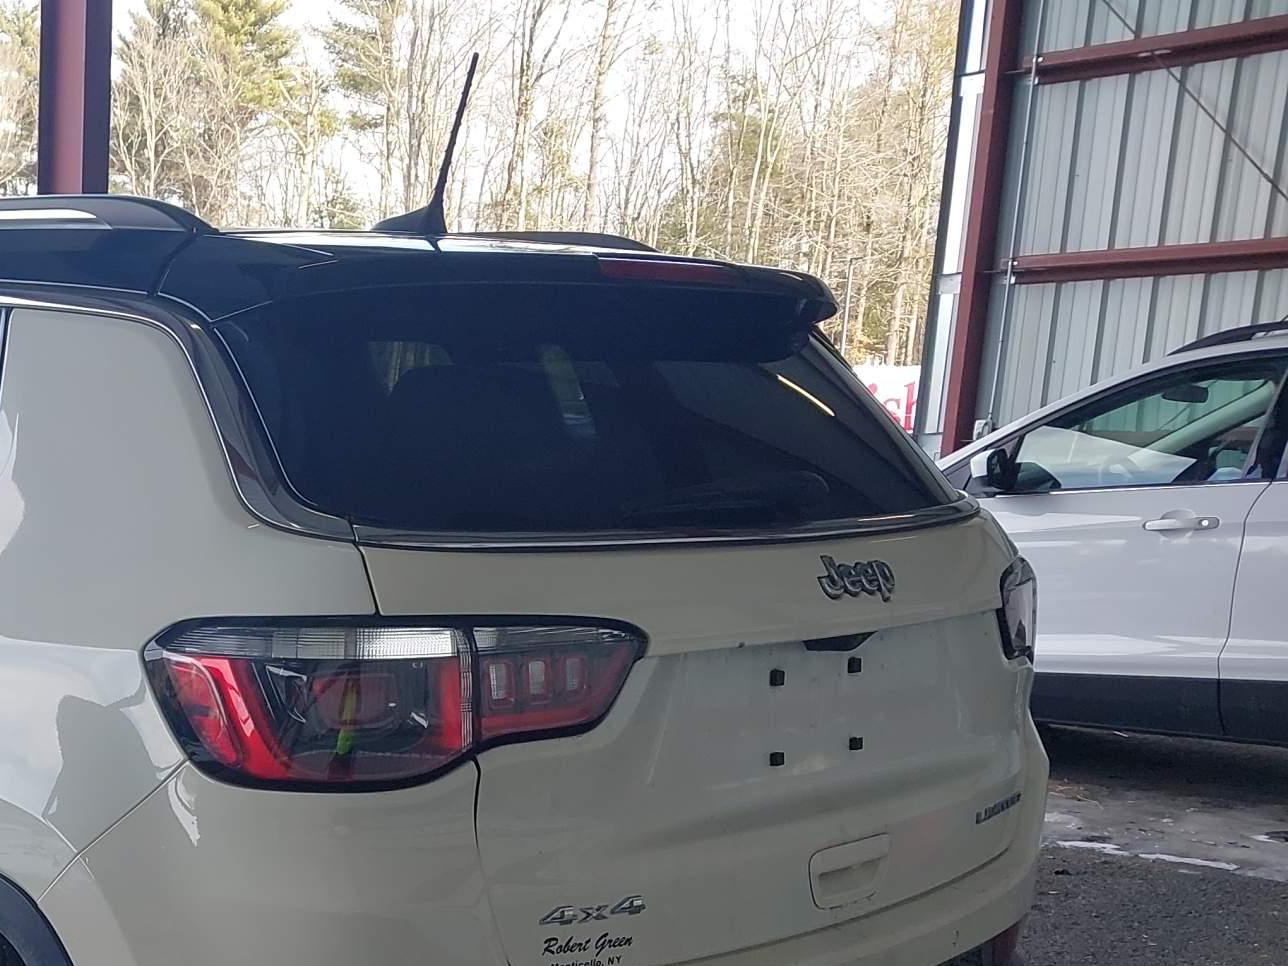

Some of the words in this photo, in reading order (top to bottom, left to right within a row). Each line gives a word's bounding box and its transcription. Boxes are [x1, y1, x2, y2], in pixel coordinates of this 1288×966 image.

[817, 555, 895, 602] Jeep
[542, 936, 592, 956] Robert
[595, 932, 633, 958] Green
[607, 955, 622, 966] NY
